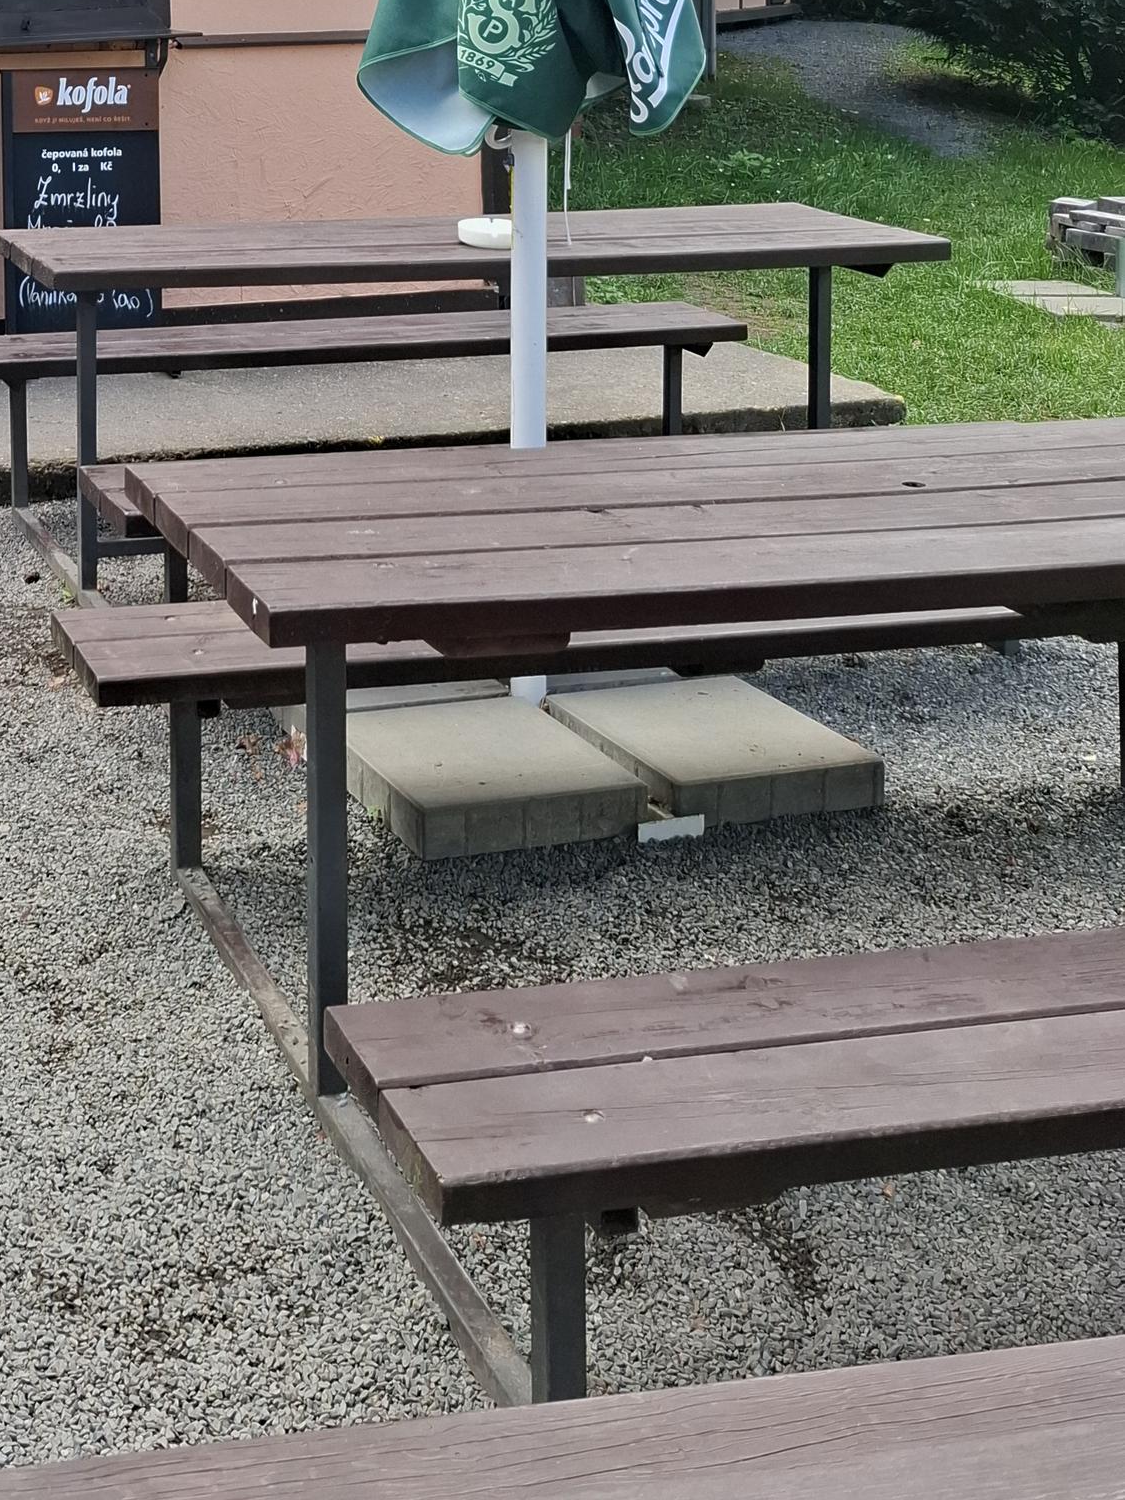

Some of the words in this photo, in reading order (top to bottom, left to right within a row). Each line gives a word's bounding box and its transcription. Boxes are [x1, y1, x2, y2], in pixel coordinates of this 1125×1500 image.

[483, 19, 501, 37] P
[460, 49, 495, 70] 1869
[57, 76, 128, 113] kofola
[42, 148, 88, 161] čepovaná
[91, 147, 122, 158] kofola
[52, 162, 61, 173] 0,
[78, 163, 89, 171] za
[101, 161, 112, 171] Kč
[33, 176, 120, 220] Zmrzliny
